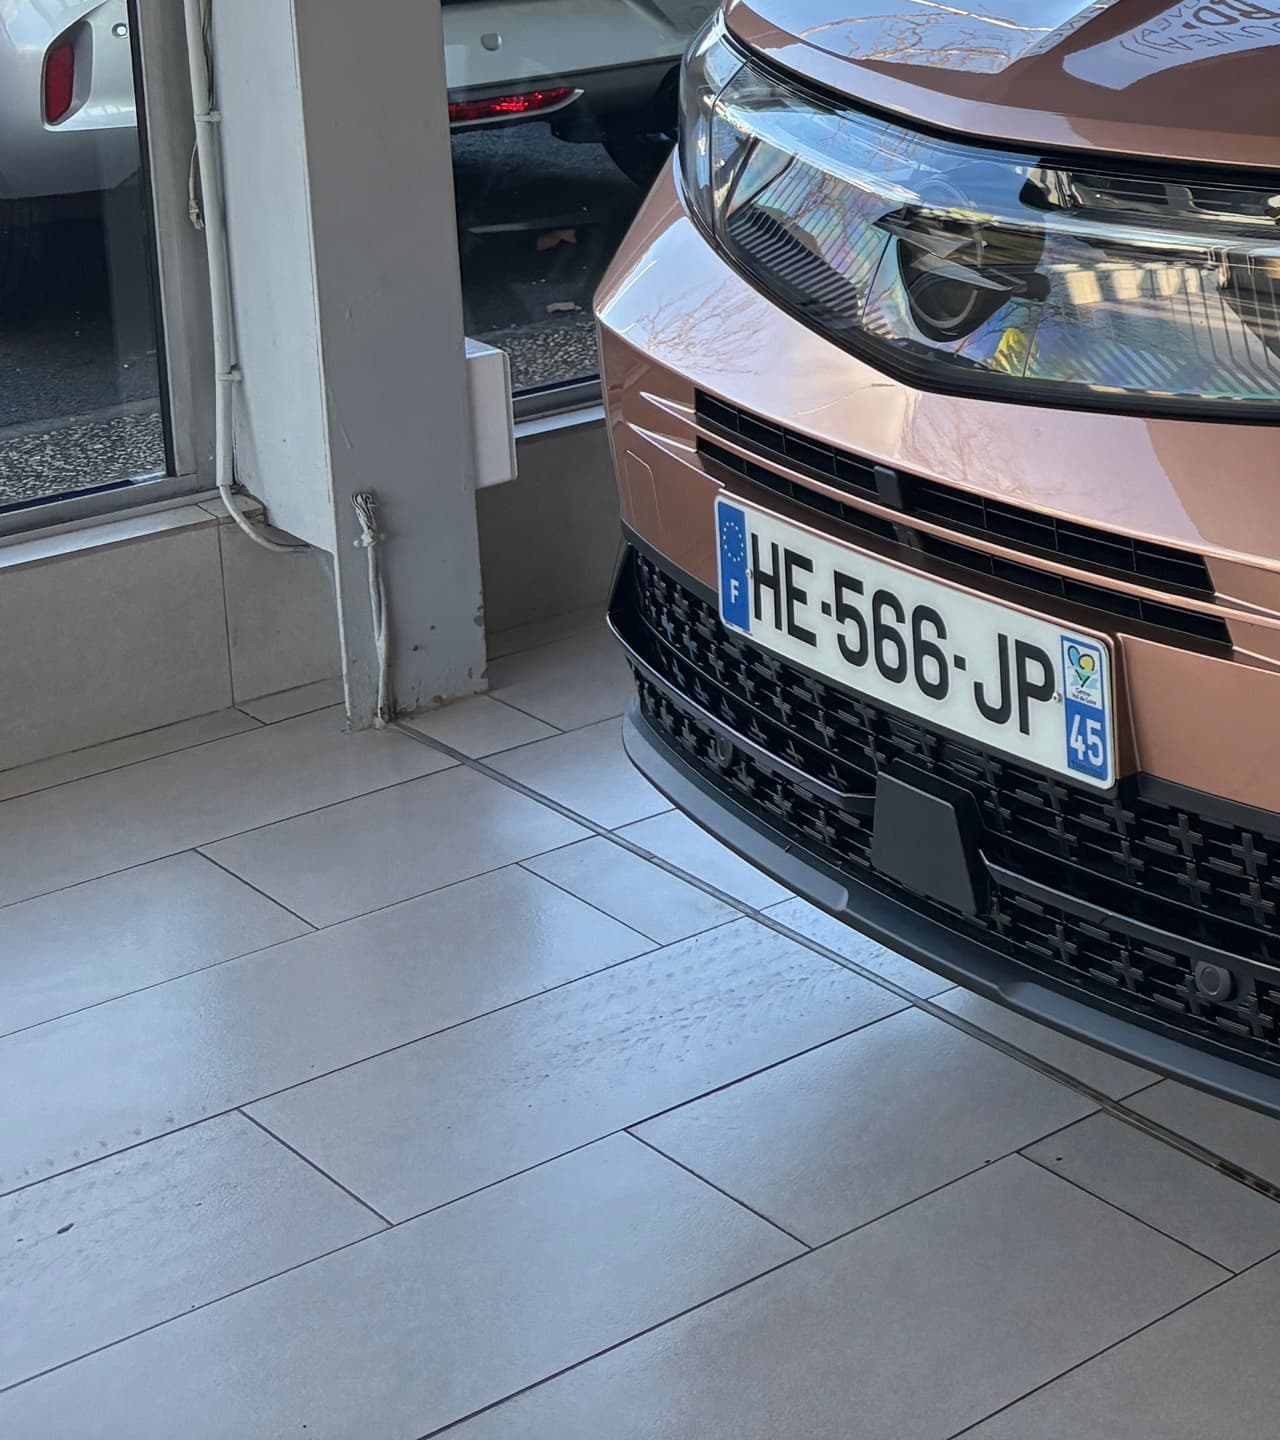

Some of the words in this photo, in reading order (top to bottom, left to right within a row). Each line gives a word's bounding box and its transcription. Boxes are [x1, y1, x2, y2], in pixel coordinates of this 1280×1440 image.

[729, 578, 740, 605] F
[751, 532, 1056, 736] HE-566-JP
[1070, 714, 1104, 767] 45
